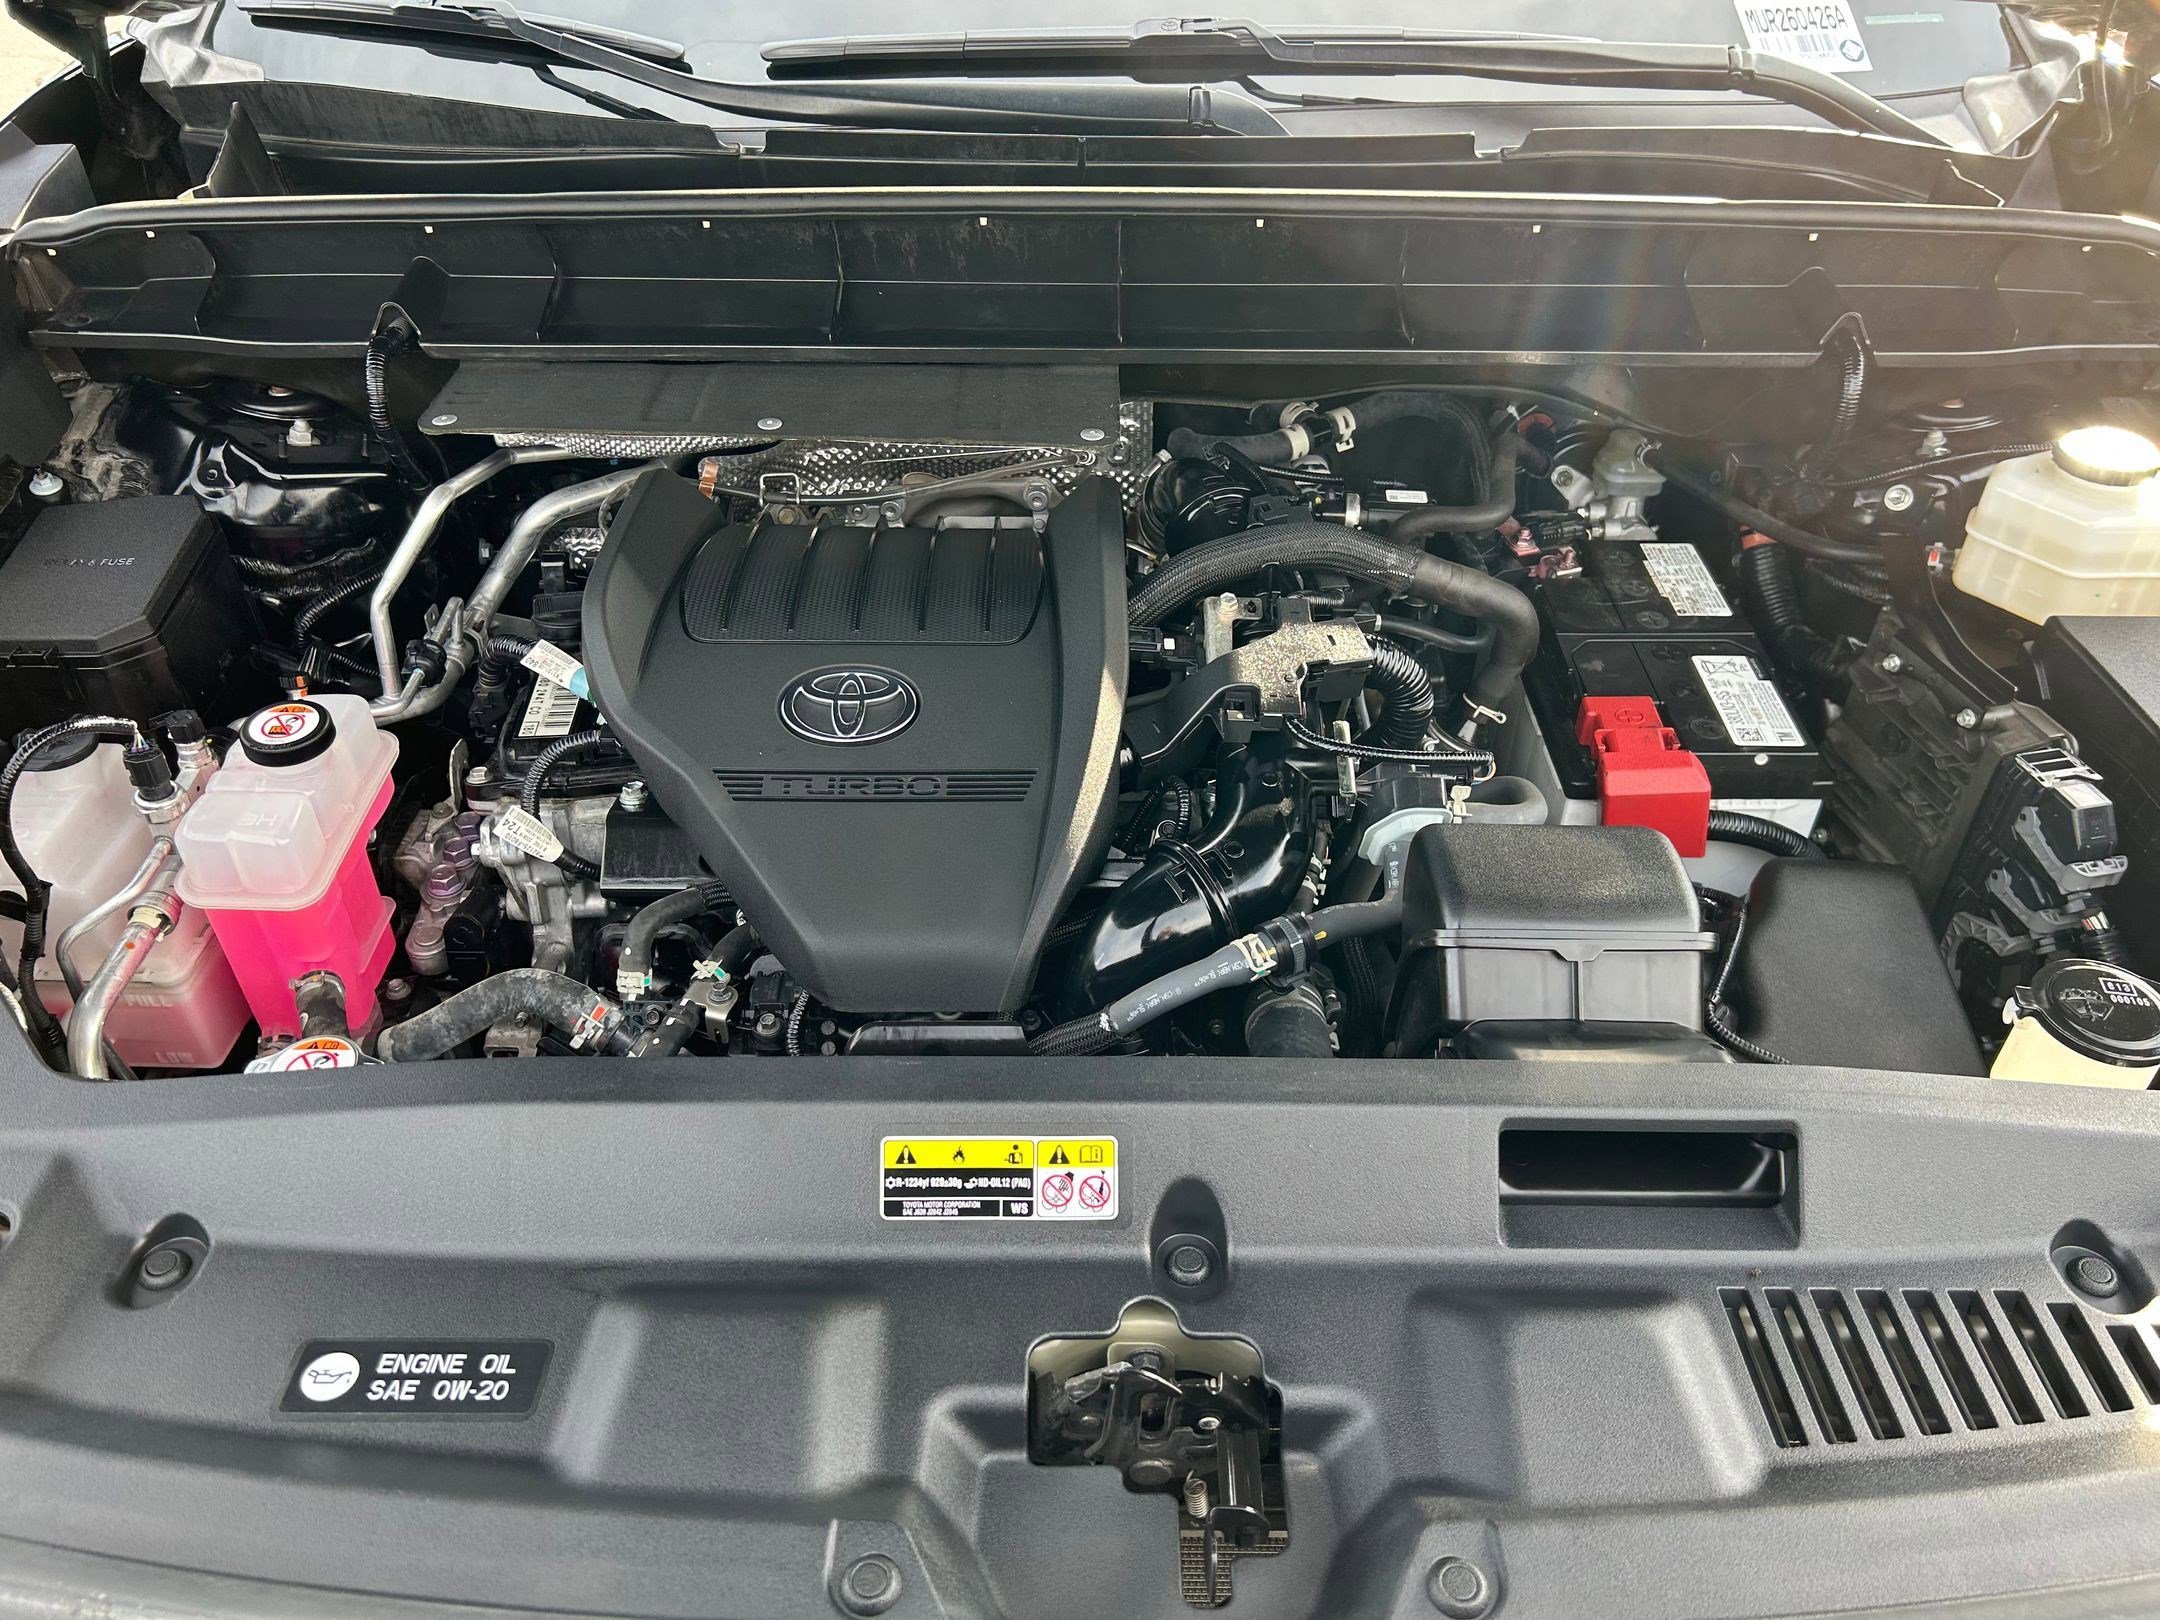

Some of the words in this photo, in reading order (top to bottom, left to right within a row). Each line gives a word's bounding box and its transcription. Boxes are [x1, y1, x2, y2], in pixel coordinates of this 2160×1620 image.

[100, 557, 136, 566] FUSE
[771, 777, 940, 796] TURBO
[502, 819, 521, 835] T24
[2110, 994, 2151, 1007] 000105
[944, 1201, 981, 1209] CORPORATION
[1010, 1202, 1029, 1215] WS
[376, 1353, 467, 1374] ENGINE
[479, 1354, 516, 1374] OIL
[366, 1380, 421, 1400] SAE
[432, 1380, 510, 1401] 0W-20
